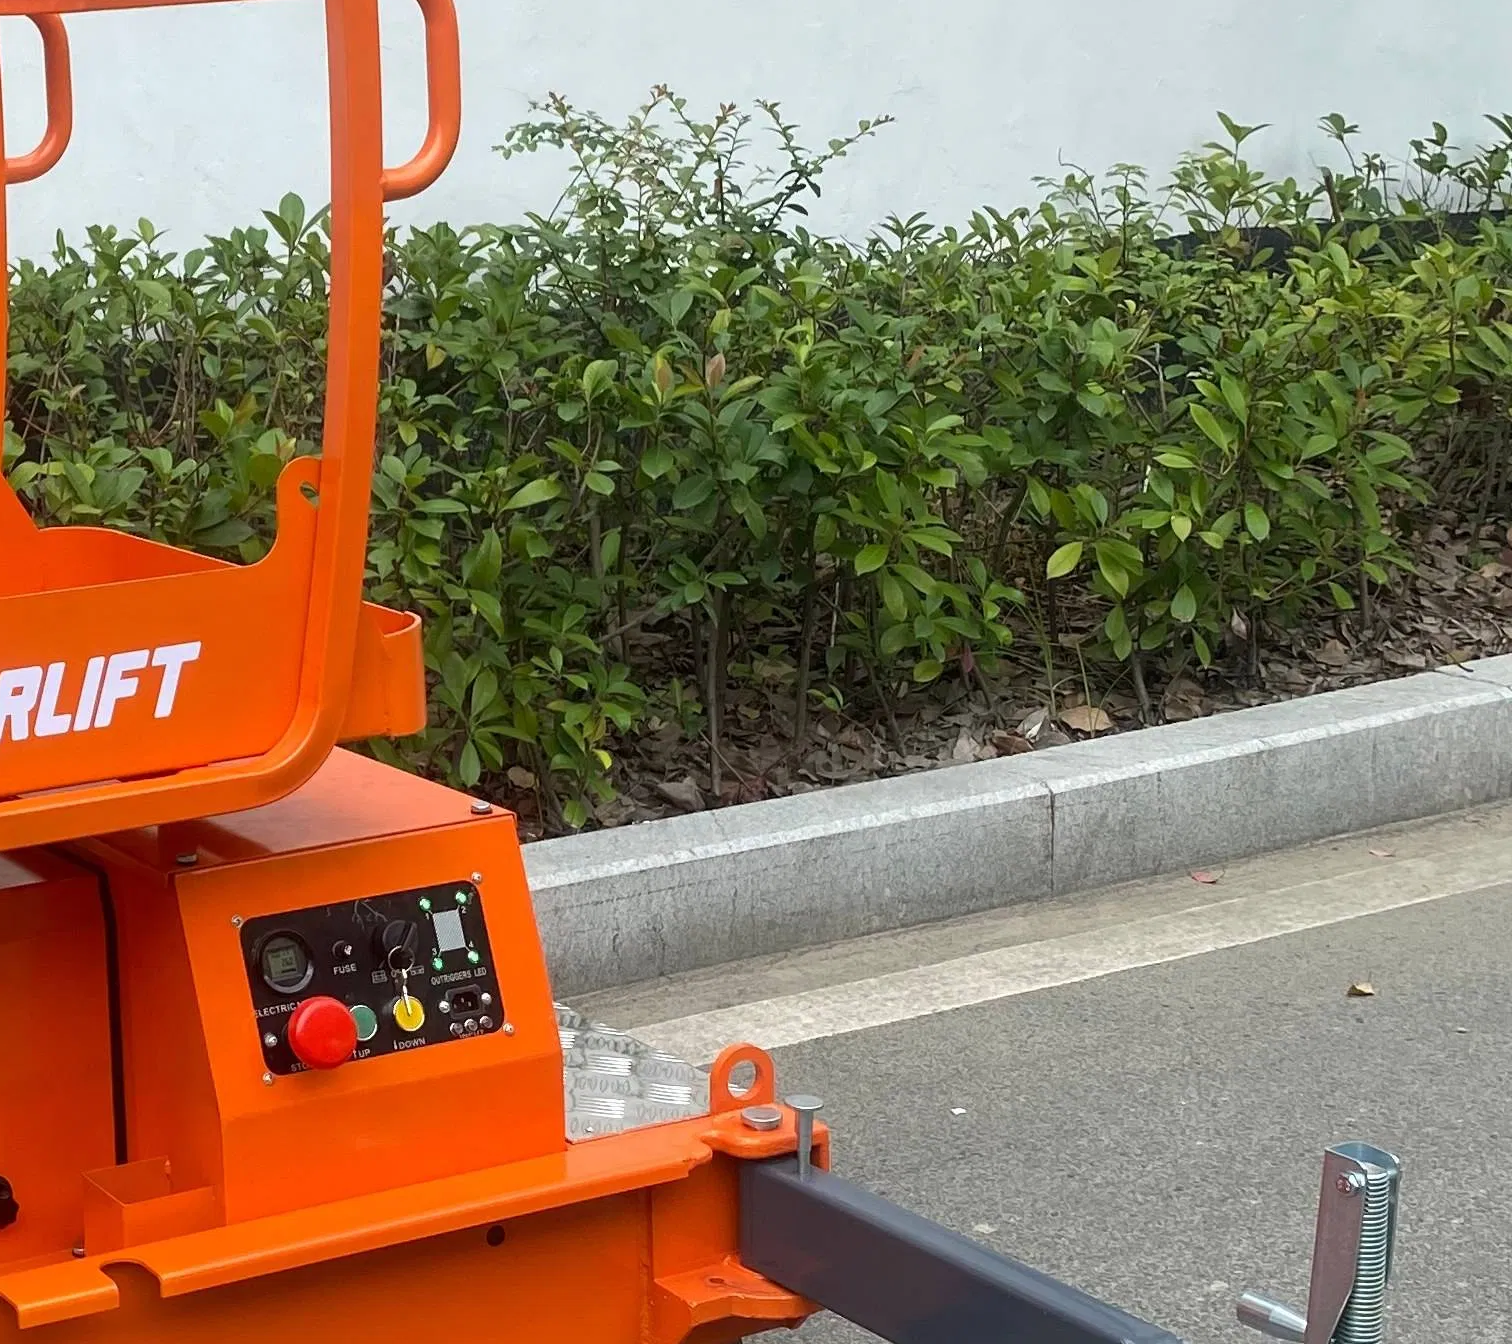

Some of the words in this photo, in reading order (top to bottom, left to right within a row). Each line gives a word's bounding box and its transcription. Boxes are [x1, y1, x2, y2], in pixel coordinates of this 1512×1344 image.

[333, 963, 357, 975] FUSE
[430, 970, 472, 986] OUTRIGGERS
[473, 967, 487, 977] LED
[255, 1001, 301, 1019] ELECTRIC
[399, 1037, 426, 1050] DOWN
[358, 1048, 371, 1058] UP
